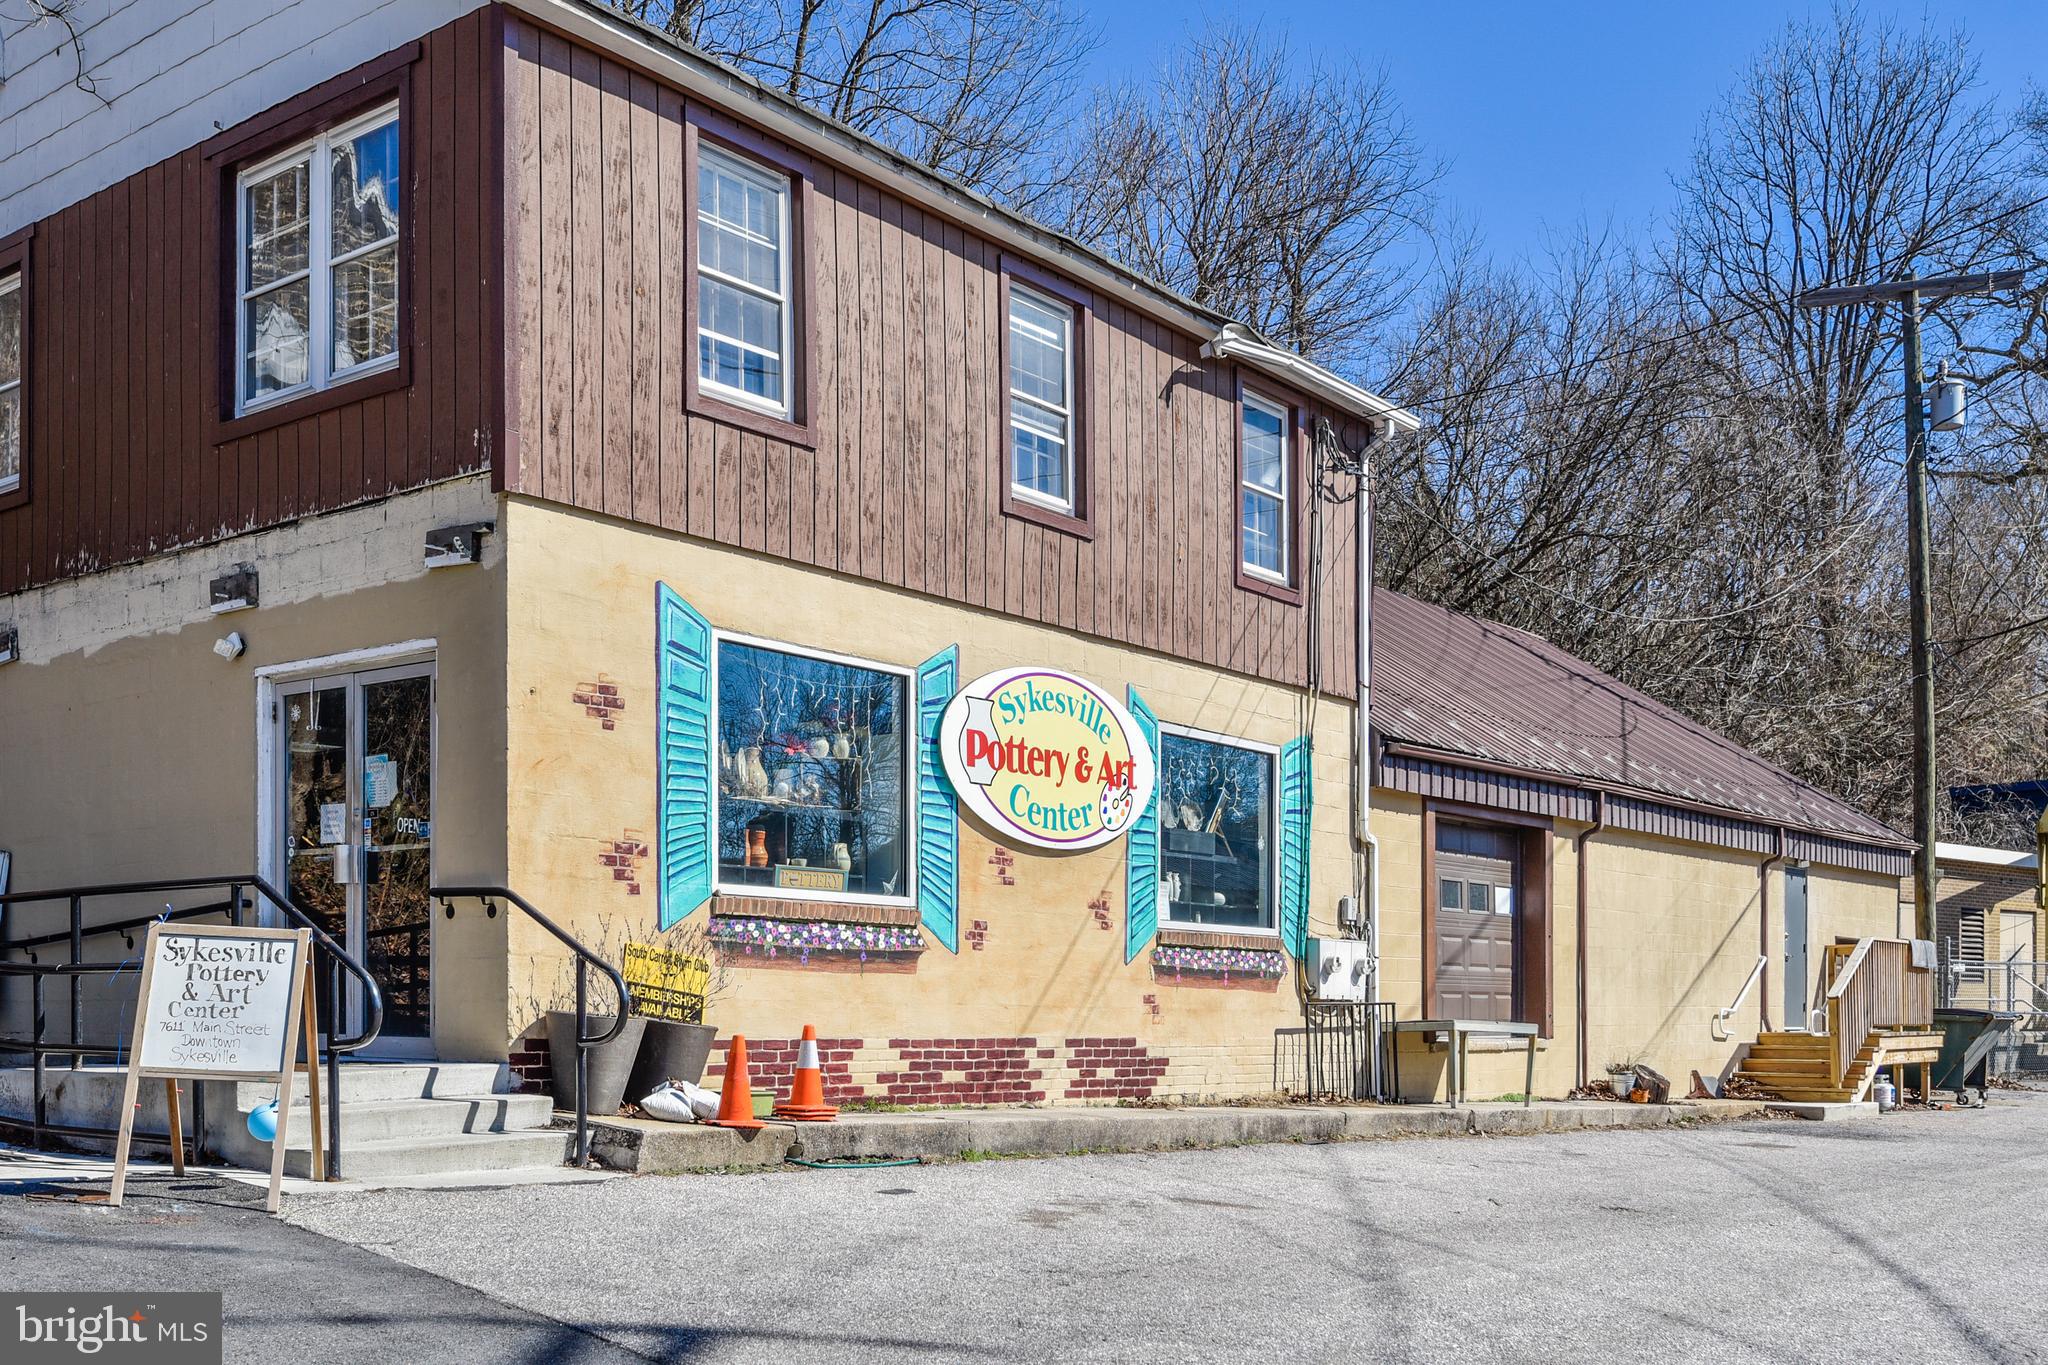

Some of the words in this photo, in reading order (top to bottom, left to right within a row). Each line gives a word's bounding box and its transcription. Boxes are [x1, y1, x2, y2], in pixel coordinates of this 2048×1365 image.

[998, 680, 1112, 745] Sykesville
[966, 728, 1070, 787] Pottery
[1074, 746, 1093, 784] &
[1096, 751, 1138, 790] Art
[1009, 783, 1093, 832] Center
[397, 817, 420, 834] OPEN
[162, 936, 288, 967] Sykesville
[626, 943, 648, 960] South
[694, 958, 709, 974] Club
[185, 963, 269, 986] Pottery
[182, 982, 198, 1001] &
[206, 983, 253, 1005] Art
[629, 985, 702, 1009] MEMBERSHIPS
[168, 1001, 245, 1019] Center
[639, 1001, 692, 1021] AVAILABLE
[192, 1021, 222, 1033] Main
[224, 1020, 271, 1036] Street
[169, 1046, 238, 1066] Sykesville
